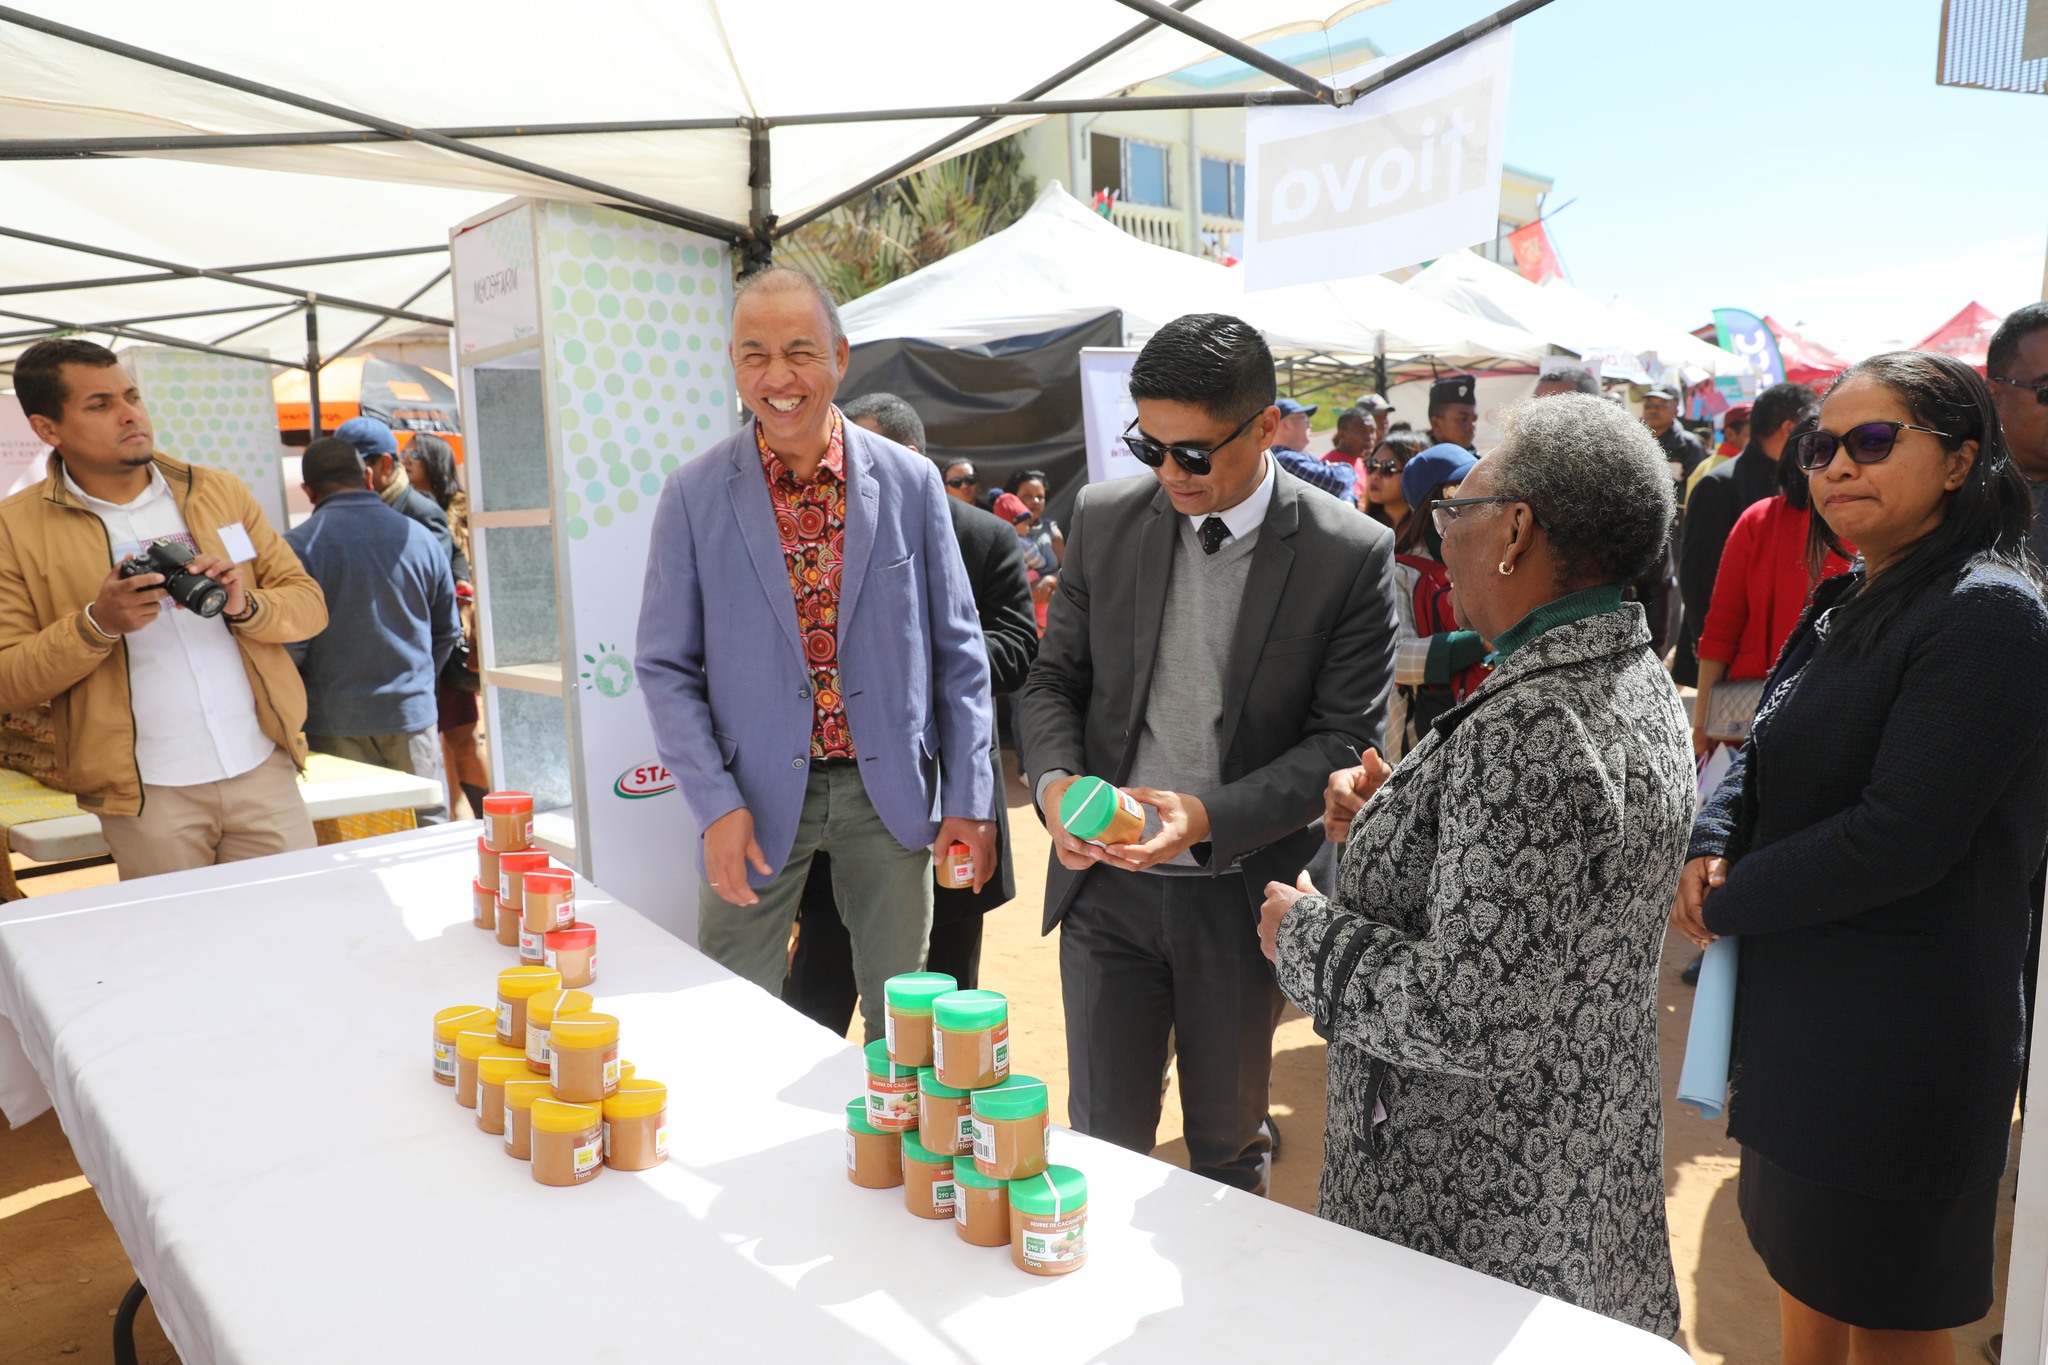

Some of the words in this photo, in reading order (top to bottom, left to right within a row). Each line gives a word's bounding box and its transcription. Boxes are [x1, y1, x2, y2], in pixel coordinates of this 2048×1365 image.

[635, 765, 673, 785] STA
[958, 1142, 973, 1150] tiav
[934, 1207, 953, 1215] tiava
[1024, 1258, 1042, 1268] tiava
